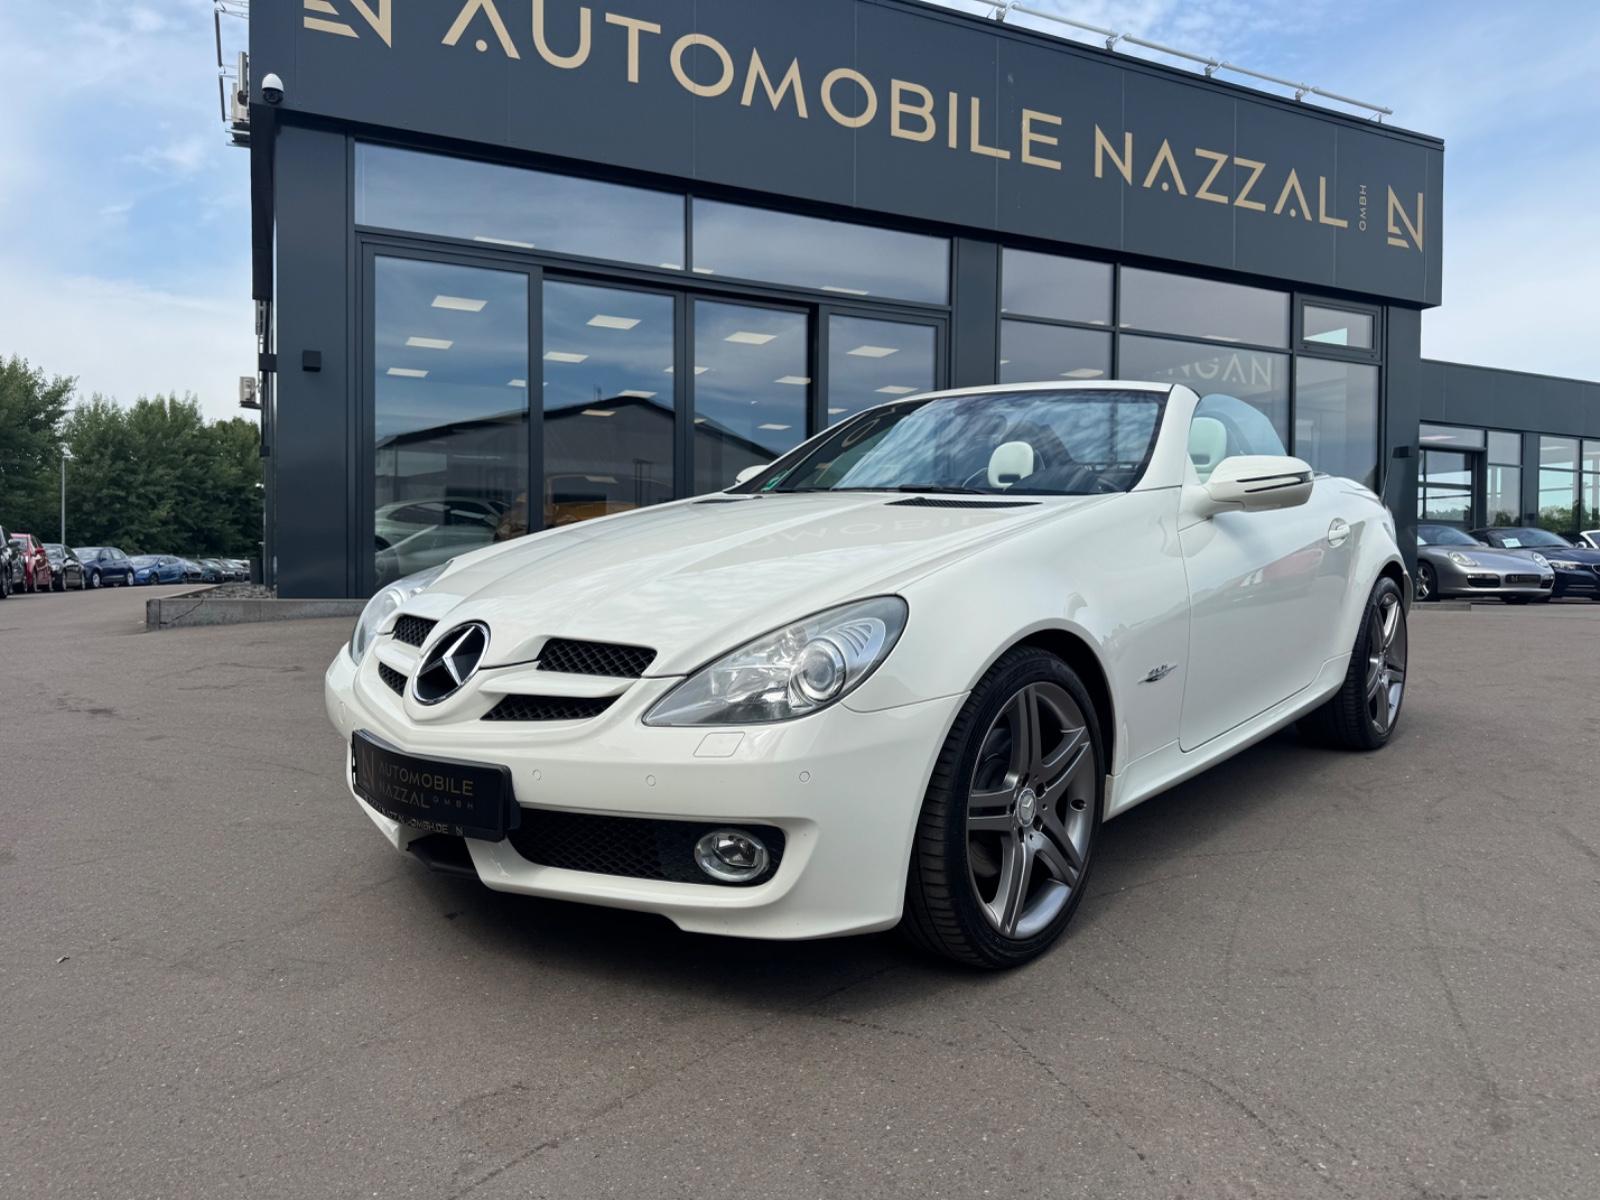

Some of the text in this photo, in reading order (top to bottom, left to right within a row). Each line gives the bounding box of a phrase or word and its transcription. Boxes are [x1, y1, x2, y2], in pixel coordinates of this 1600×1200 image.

[443, 0, 1348, 229] AUTOMOBILE NAZZAL
[378, 761, 474, 797] AUTOMOBILE
